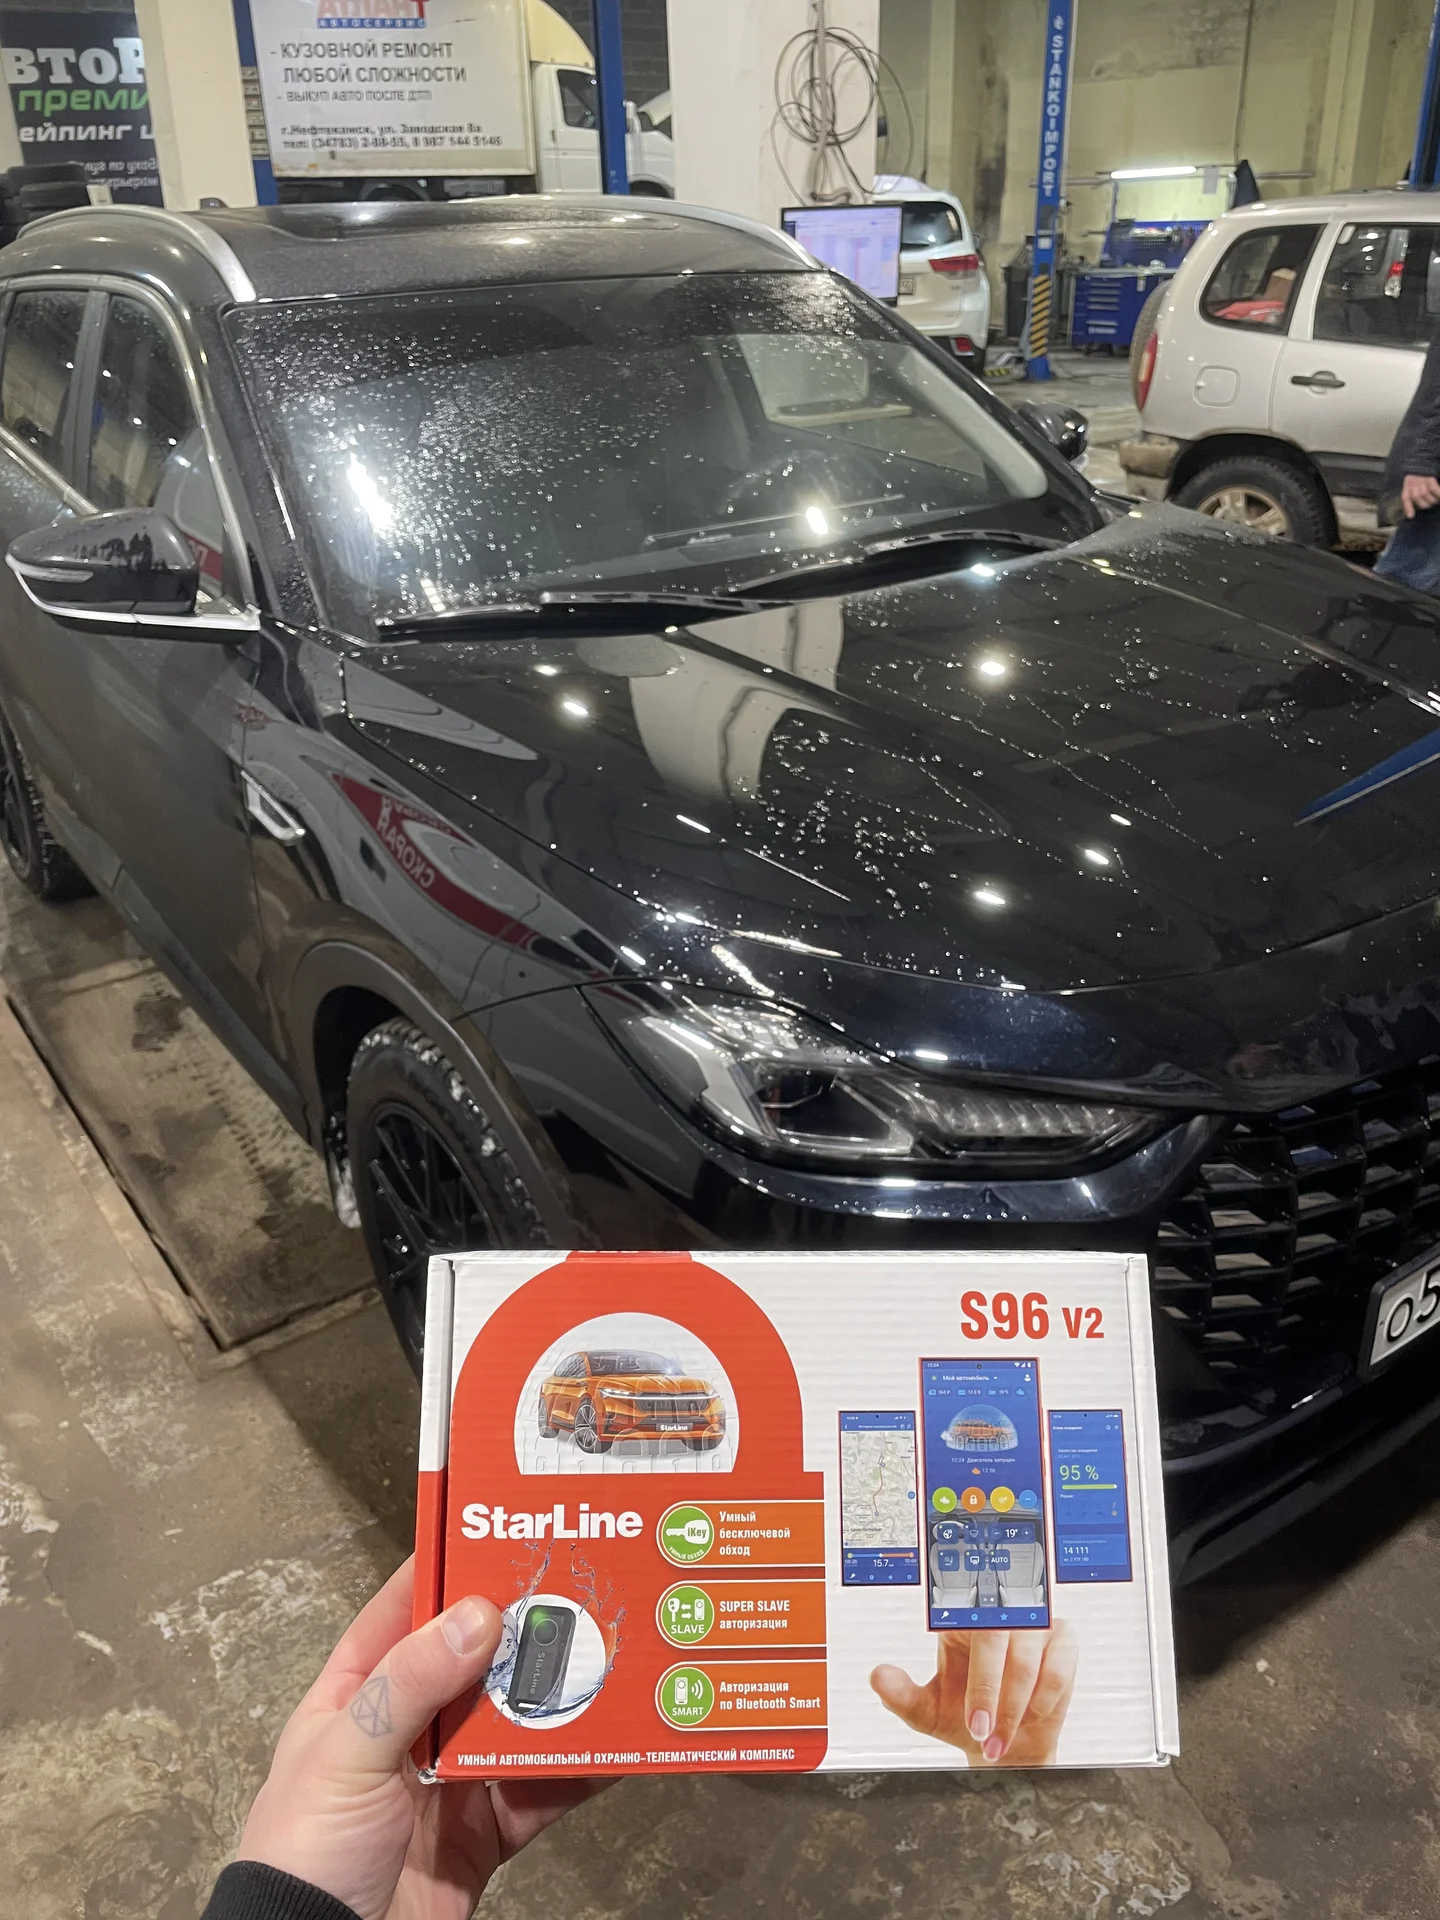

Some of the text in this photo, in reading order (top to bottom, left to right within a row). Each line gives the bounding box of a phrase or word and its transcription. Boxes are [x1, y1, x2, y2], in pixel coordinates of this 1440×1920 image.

[280, 39, 453, 58] КУЗОВНОЙ РЕМОНТ
[283, 64, 467, 83] ЛЮБОЙ СЛОЖНОСТИ
[286, 91, 329, 101] ВЫКУП
[331, 91, 364, 101] АВТО
[365, 91, 404, 101] ПОСЛЕ
[1042, 35, 1064, 197] STANKOIMPORT
[960, 1290, 1050, 1340] S96
[1059, 1464, 1099, 1480] 95 %
[461, 1503, 644, 1539] StarLine
[719, 1510, 756, 1522] Умный
[687, 1527, 707, 1538] iKey
[719, 1527, 790, 1539] бесключевой
[719, 1545, 750, 1556] обход
[873, 1559, 889, 1567] 15.7
[719, 1600, 790, 1612] SUPER SLAVE
[671, 1624, 705, 1634] SLAVE
[719, 1619, 788, 1631] авторизация
[530, 1651, 546, 1694] StarLine
[719, 1681, 789, 1694] Авторизация
[719, 1697, 820, 1709] по Bluetooth Smart
[672, 1706, 704, 1716] SMART
[457, 1752, 496, 1765] УМНЫЙ
[499, 1751, 591, 1765] АВТОМОБИЛЬНЫЙ
[740, 1748, 795, 1760] КОМПЛЕКС
